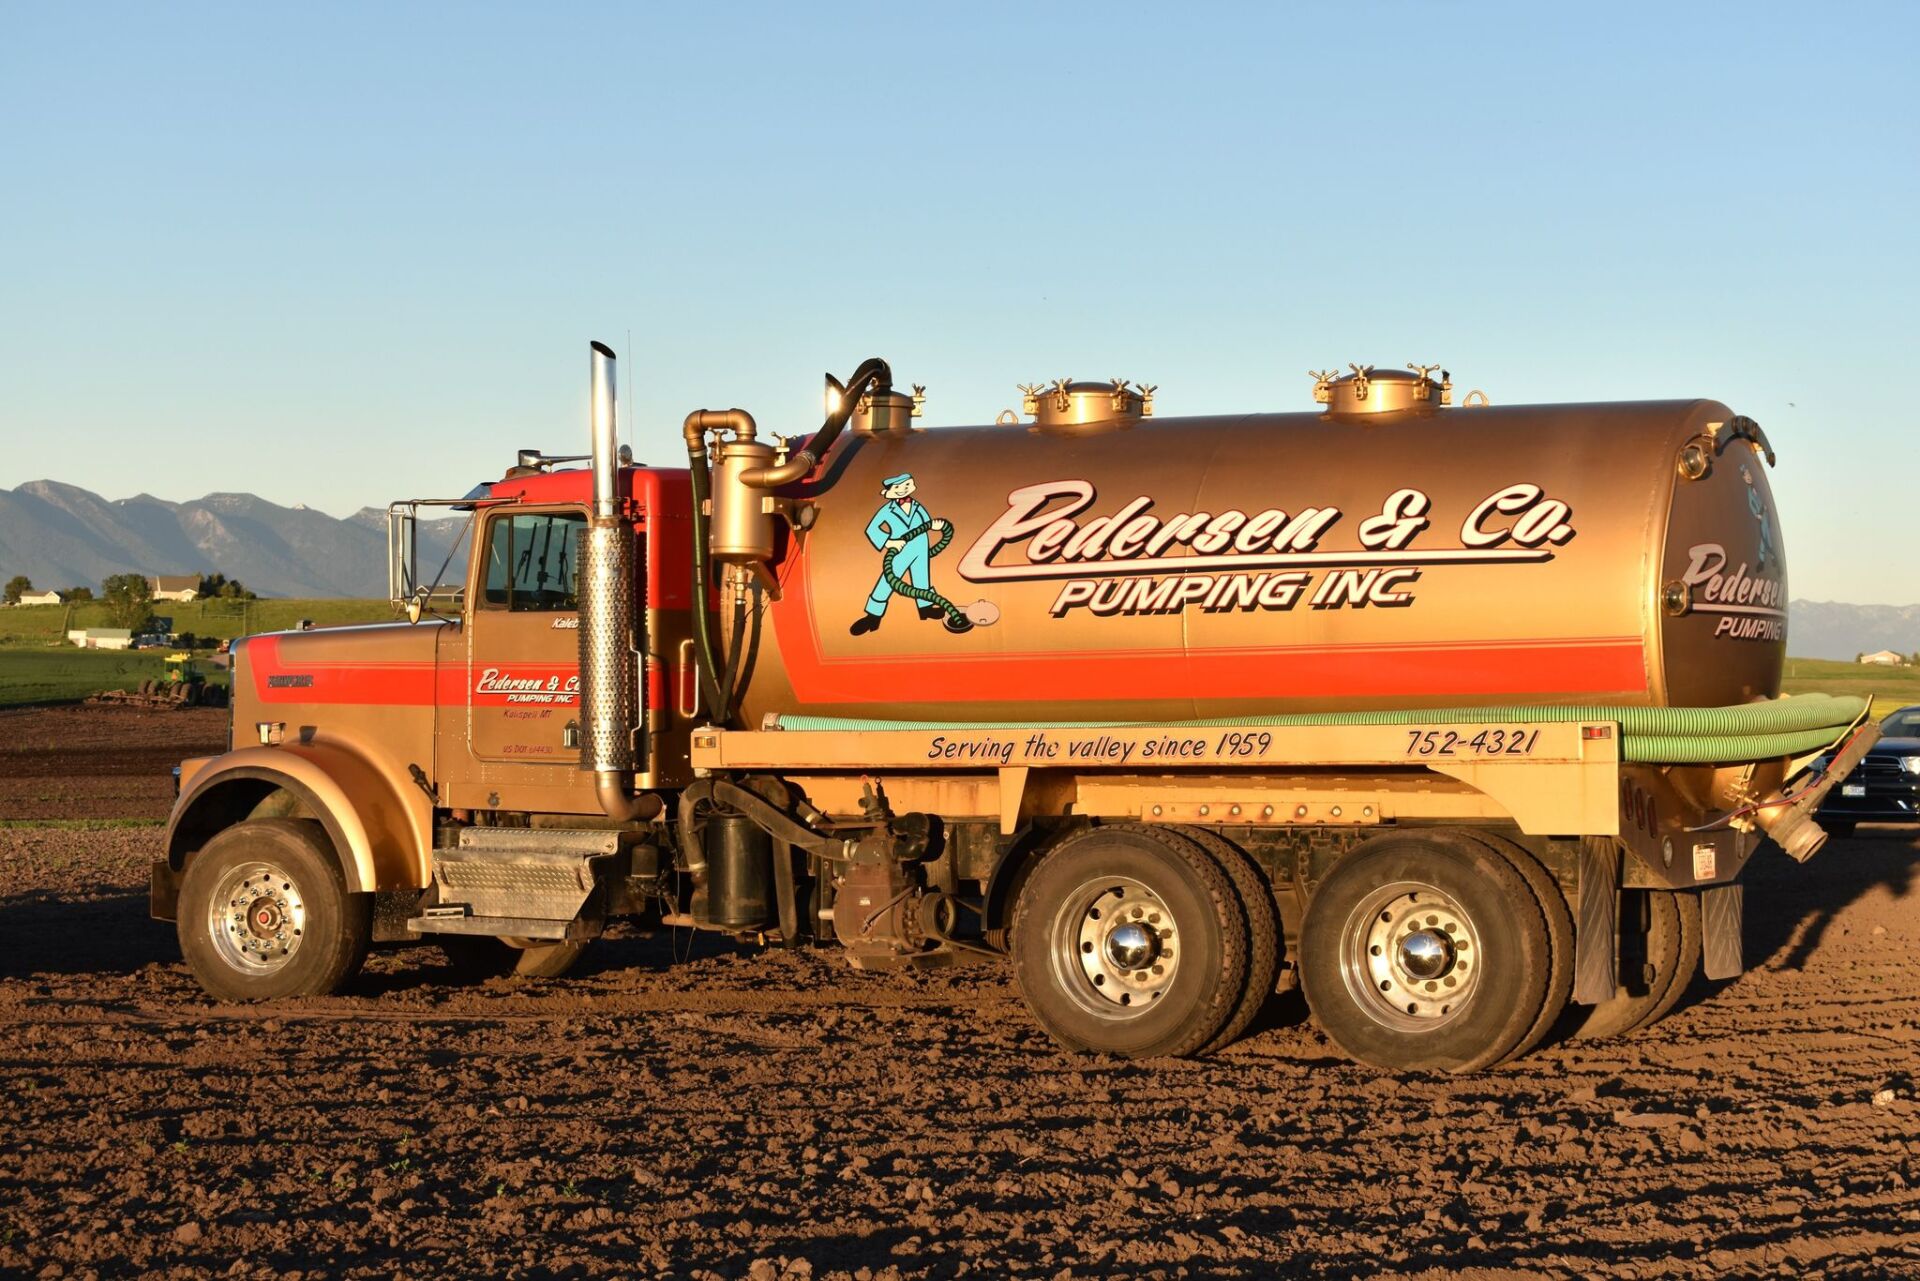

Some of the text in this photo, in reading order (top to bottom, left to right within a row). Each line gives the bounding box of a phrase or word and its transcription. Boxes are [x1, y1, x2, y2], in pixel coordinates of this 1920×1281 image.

[957, 478, 1577, 584] Pedersen & Co.
[1048, 566, 1423, 619] PUMPING INC.
[1713, 616, 1782, 641] PUMPING
[476, 668, 544, 693] Pedersen
[546, 675, 560, 691] &
[507, 694, 554, 703] PUMPING
[539, 709, 552, 718] MT
[927, 732, 1273, 764] Serving the valley since 1959
[1406, 729, 1540, 757] 752-4321
